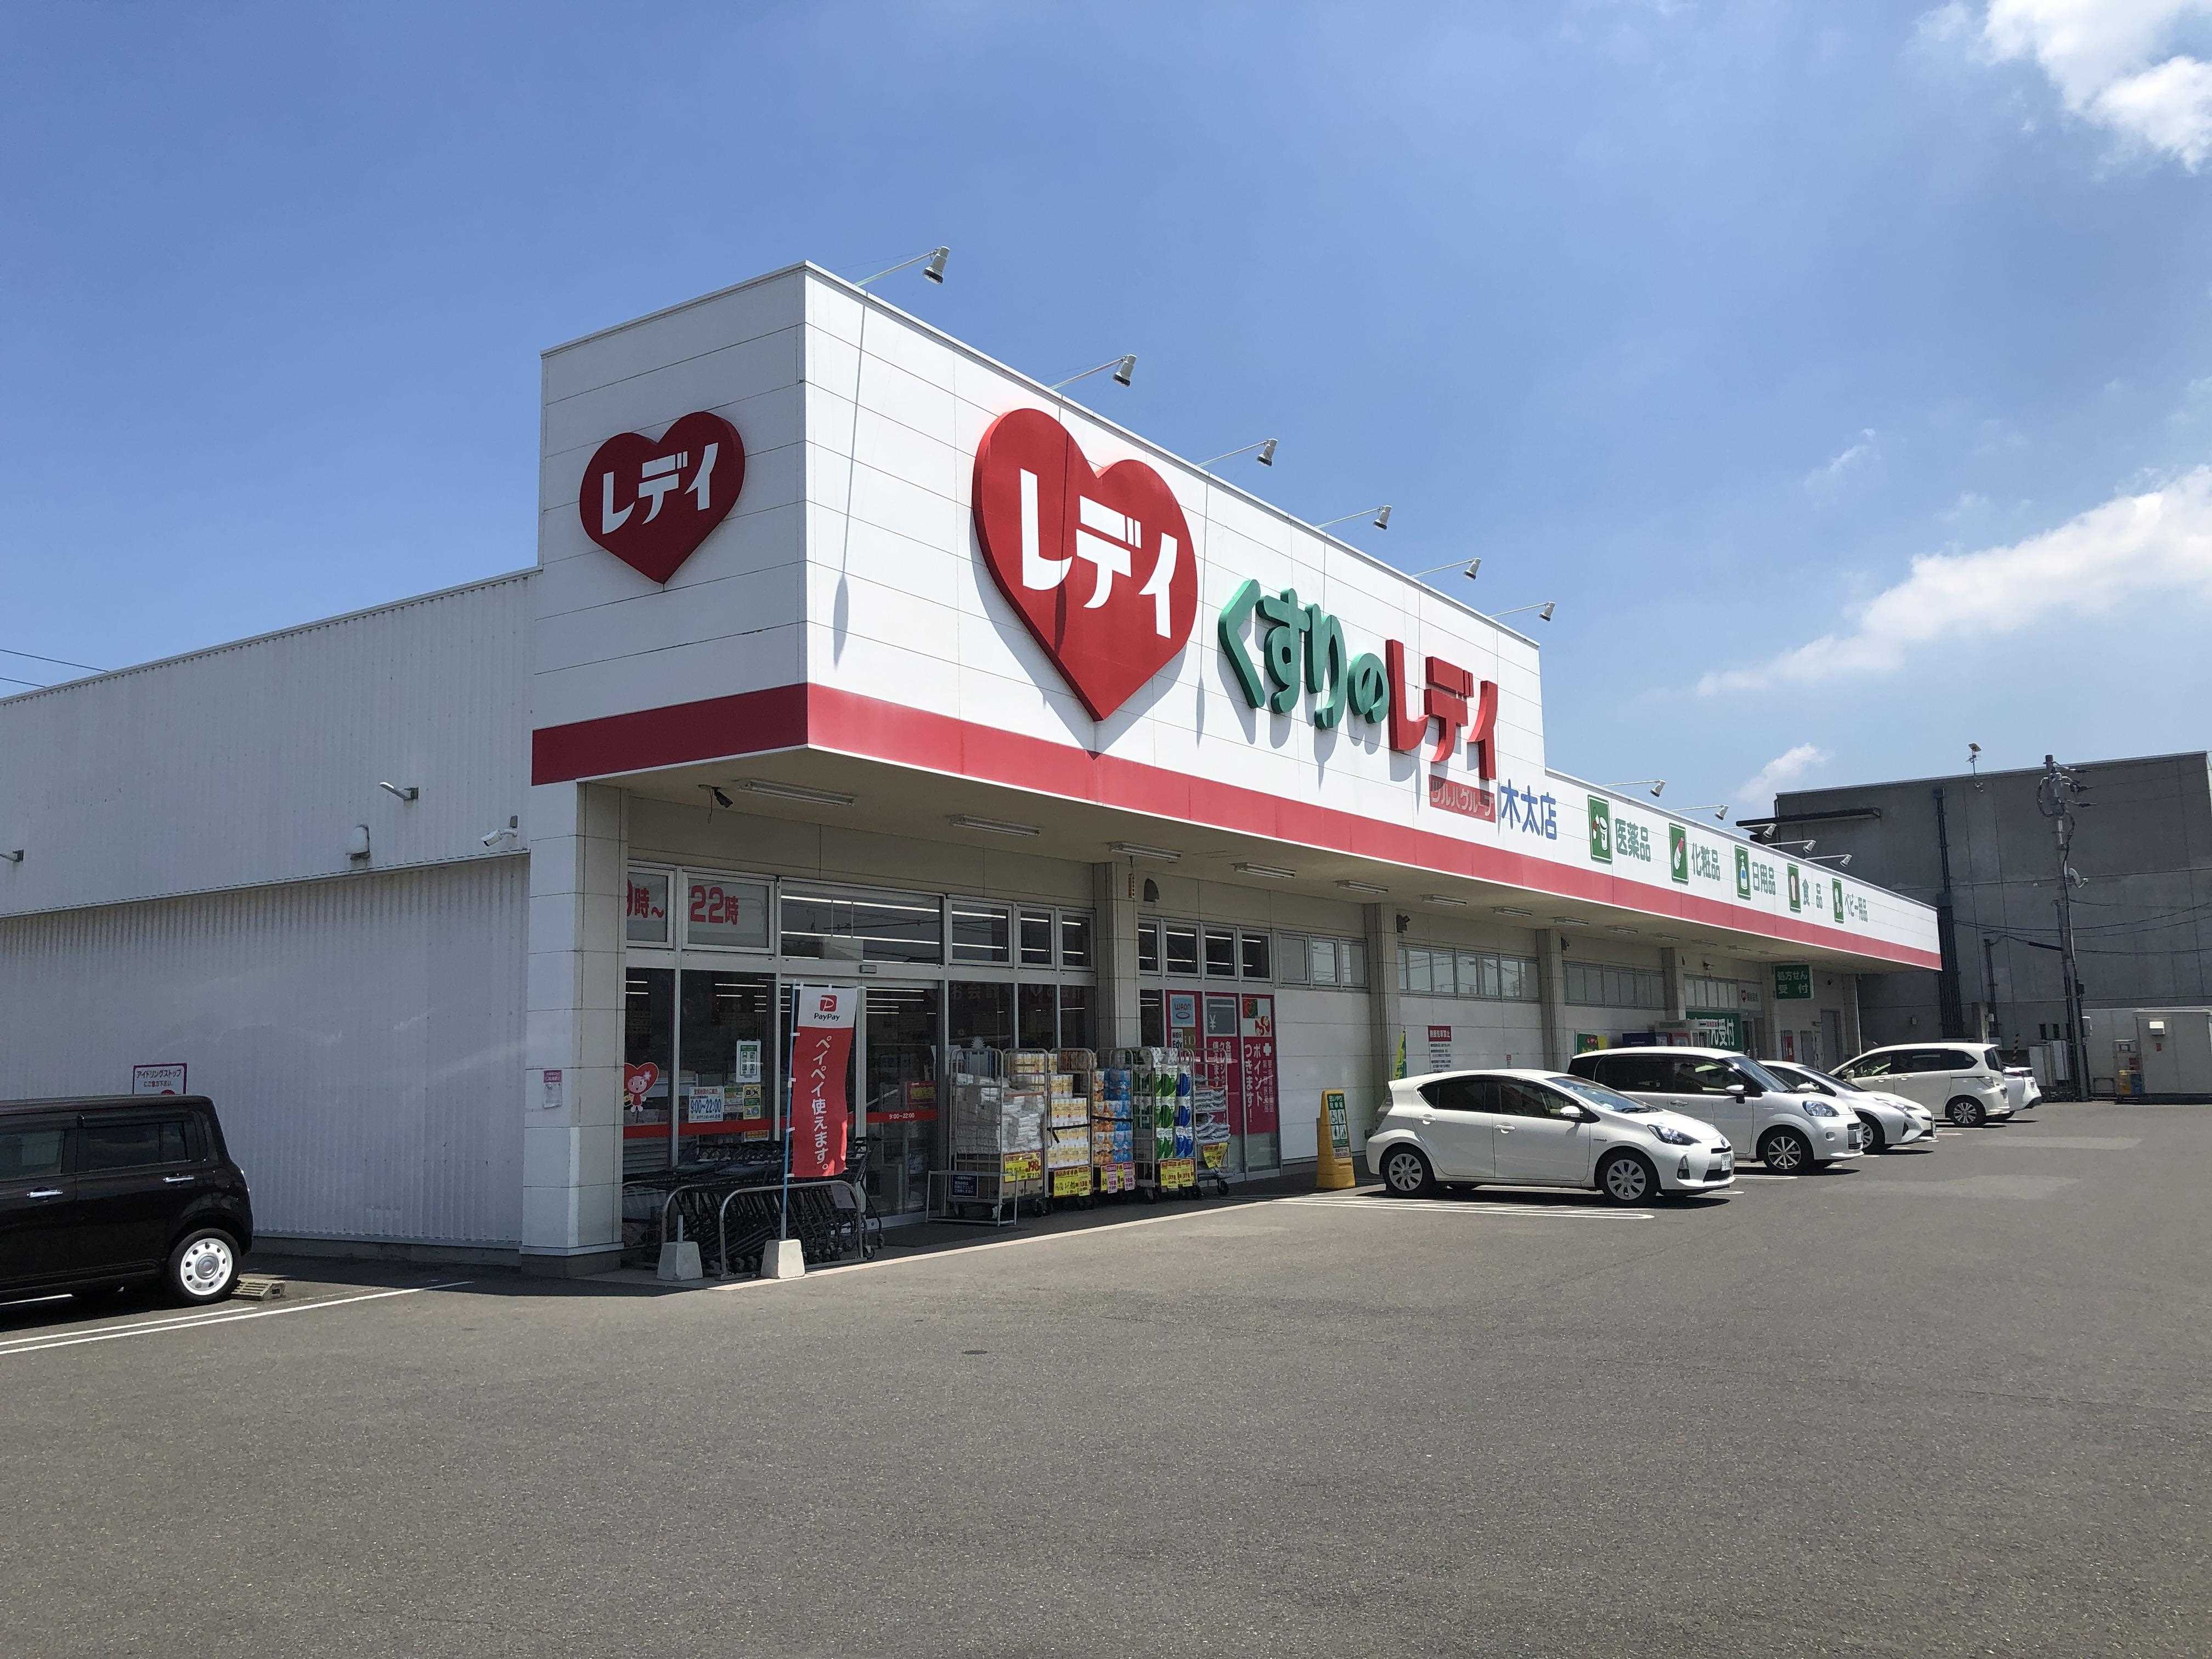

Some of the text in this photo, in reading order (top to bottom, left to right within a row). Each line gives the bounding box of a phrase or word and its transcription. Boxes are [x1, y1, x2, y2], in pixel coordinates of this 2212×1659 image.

[602, 442, 719, 534] レディ
[1020, 468, 1178, 639] レディ
[1430, 780, 1494, 816] ツルハグループ
[1500, 778, 1557, 840] 木太店
[1615, 818, 1651, 862] 医薬品
[1691, 842, 1720, 881] 化粧品
[1752, 861, 1776, 895] 日用品
[690, 885, 738, 925] 22時
[1777, 970, 1807, 980] 処方せん
[814, 1013, 840, 1021] PayPay
[137, 1069, 181, 1079] アイドリングストップ
[1253, 1043, 1262, 1107] ポイント
[811, 1035, 832, 1170] ペイペイ使えます。
